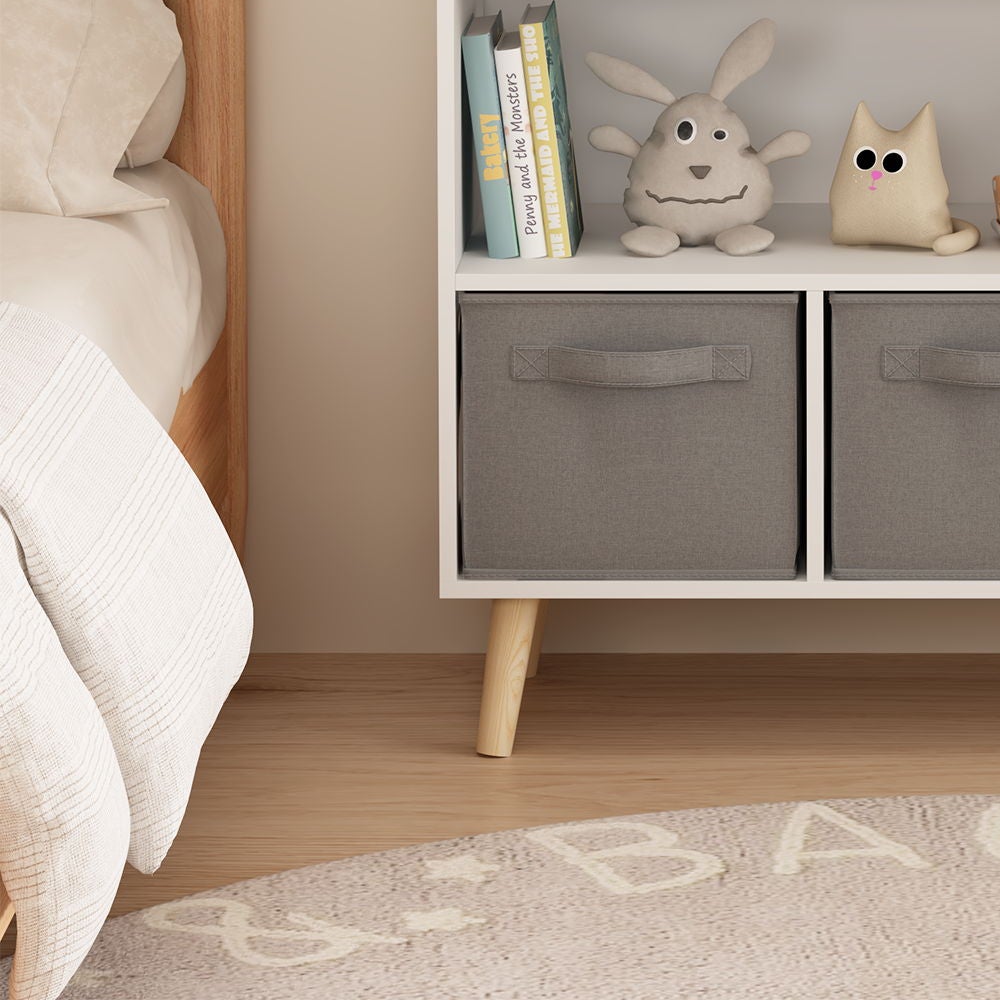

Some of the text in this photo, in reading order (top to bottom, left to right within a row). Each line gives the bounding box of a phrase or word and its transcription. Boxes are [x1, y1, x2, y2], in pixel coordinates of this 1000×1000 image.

[522, 24, 540, 63] SHO
[527, 65, 545, 102] THE
[480, 114, 505, 181] Bakery
[533, 105, 550, 142] AND
[506, 72, 538, 236] Penny and the Monsters
[538, 144, 562, 231] MERMAID
